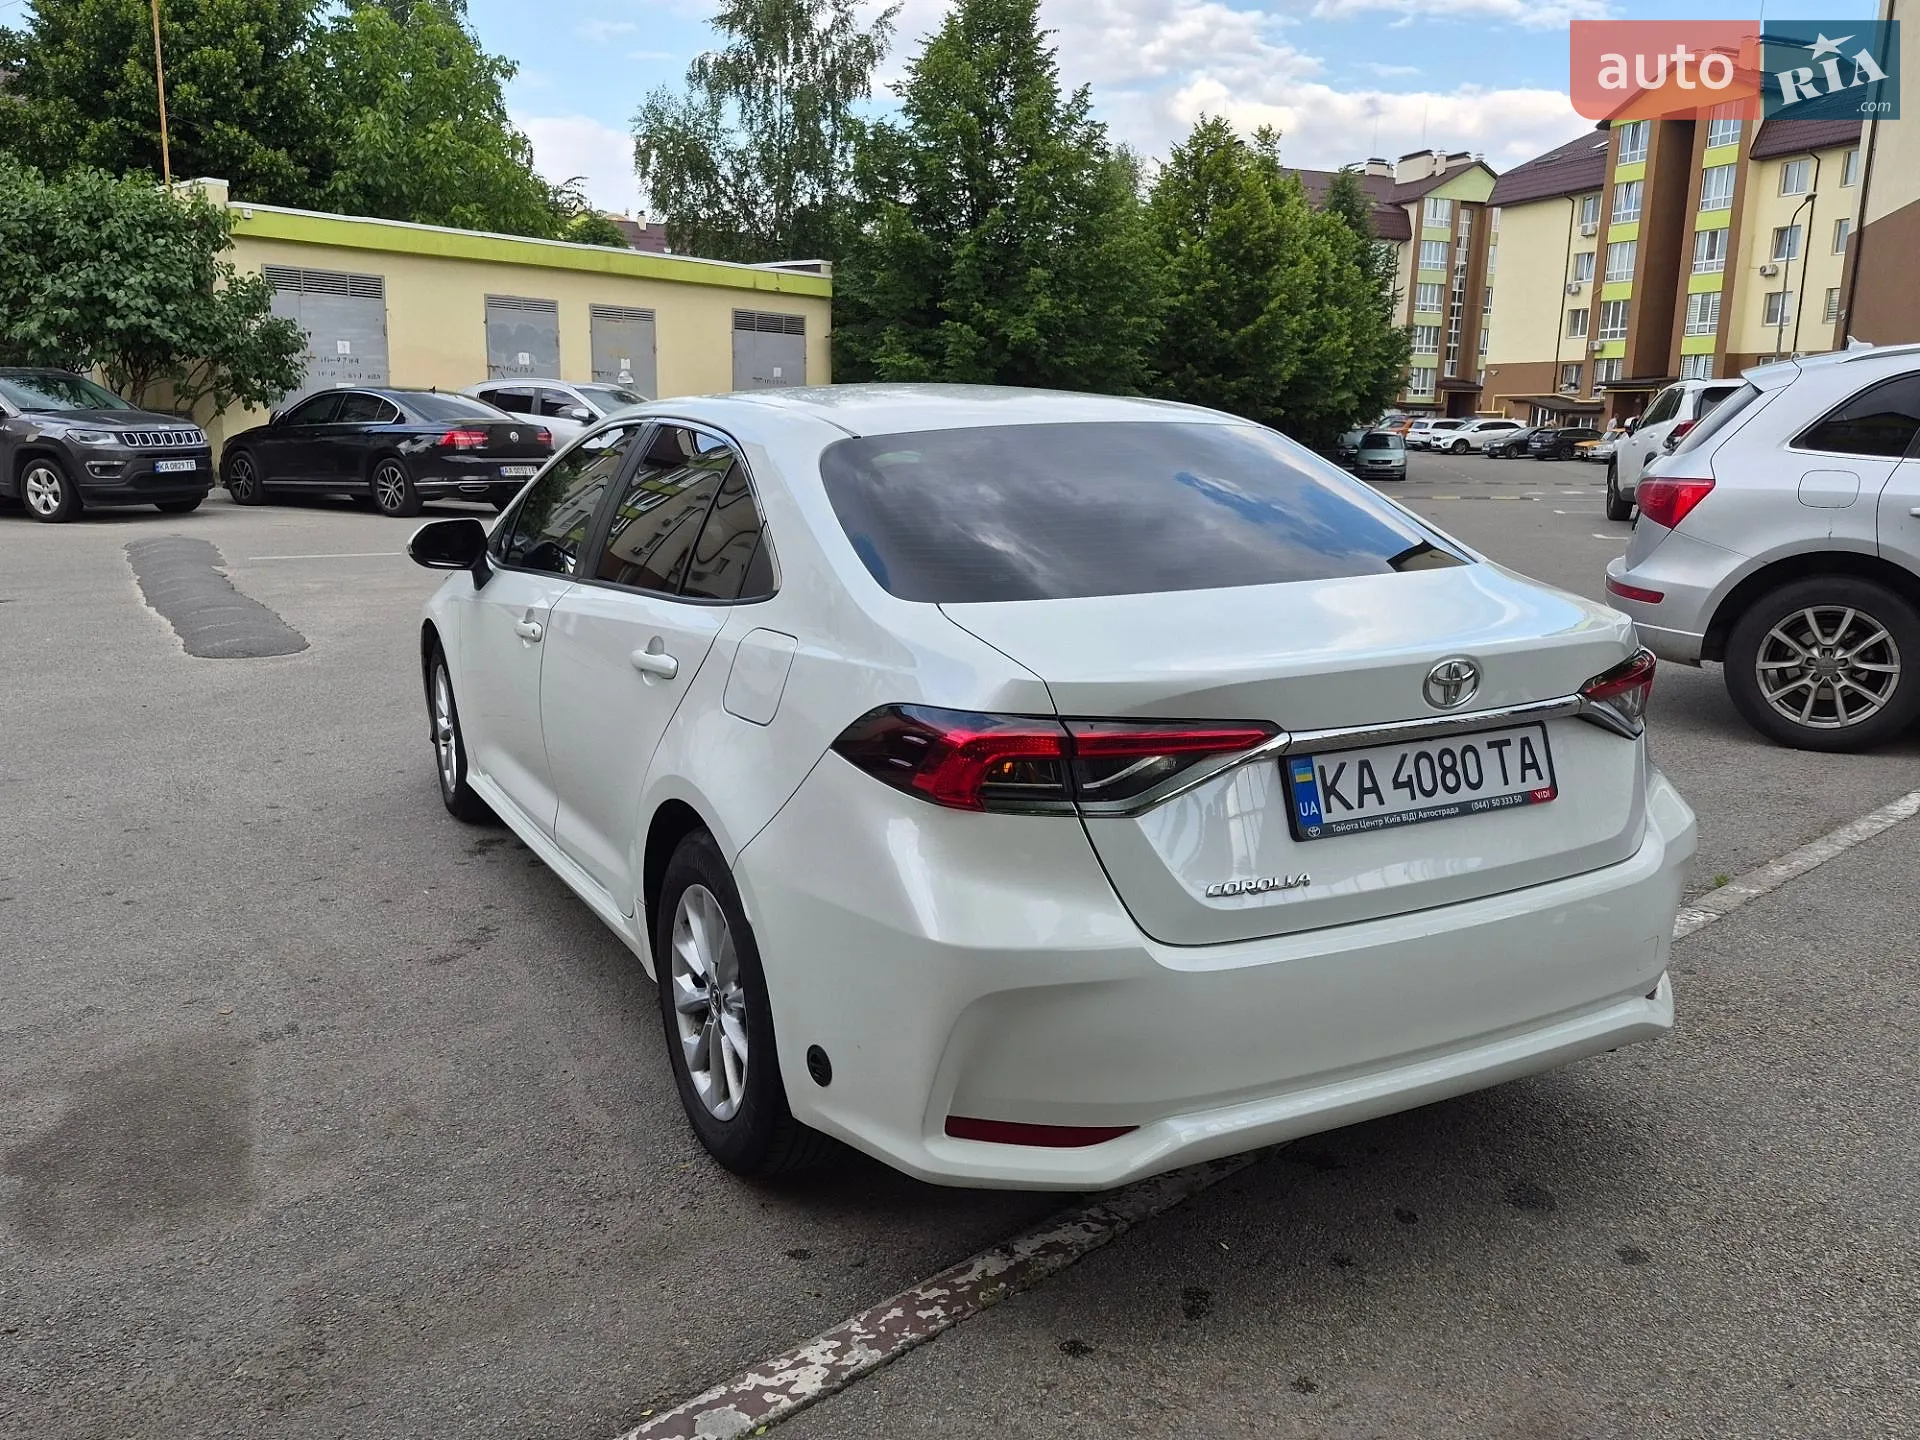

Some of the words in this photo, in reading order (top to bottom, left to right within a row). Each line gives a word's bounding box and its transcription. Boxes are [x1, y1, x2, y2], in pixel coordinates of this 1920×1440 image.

[1317, 759, 1385, 814] KA
[1392, 744, 1484, 801] 4080
[1486, 736, 1544, 787] TA
[1299, 801, 1319, 816] UA
[1471, 799, 1490, 811] (044)
[1491, 798, 1500, 807] 50
[1501, 797, 1513, 806] 333
[1514, 795, 1523, 804] 50
[1332, 821, 1359, 833] Тойота
[1359, 818, 1384, 830] Центр
[1384, 815, 1401, 825] Київ
[1418, 806, 1459, 819] Автострада
[1205, 872, 1311, 898] COROLLA
